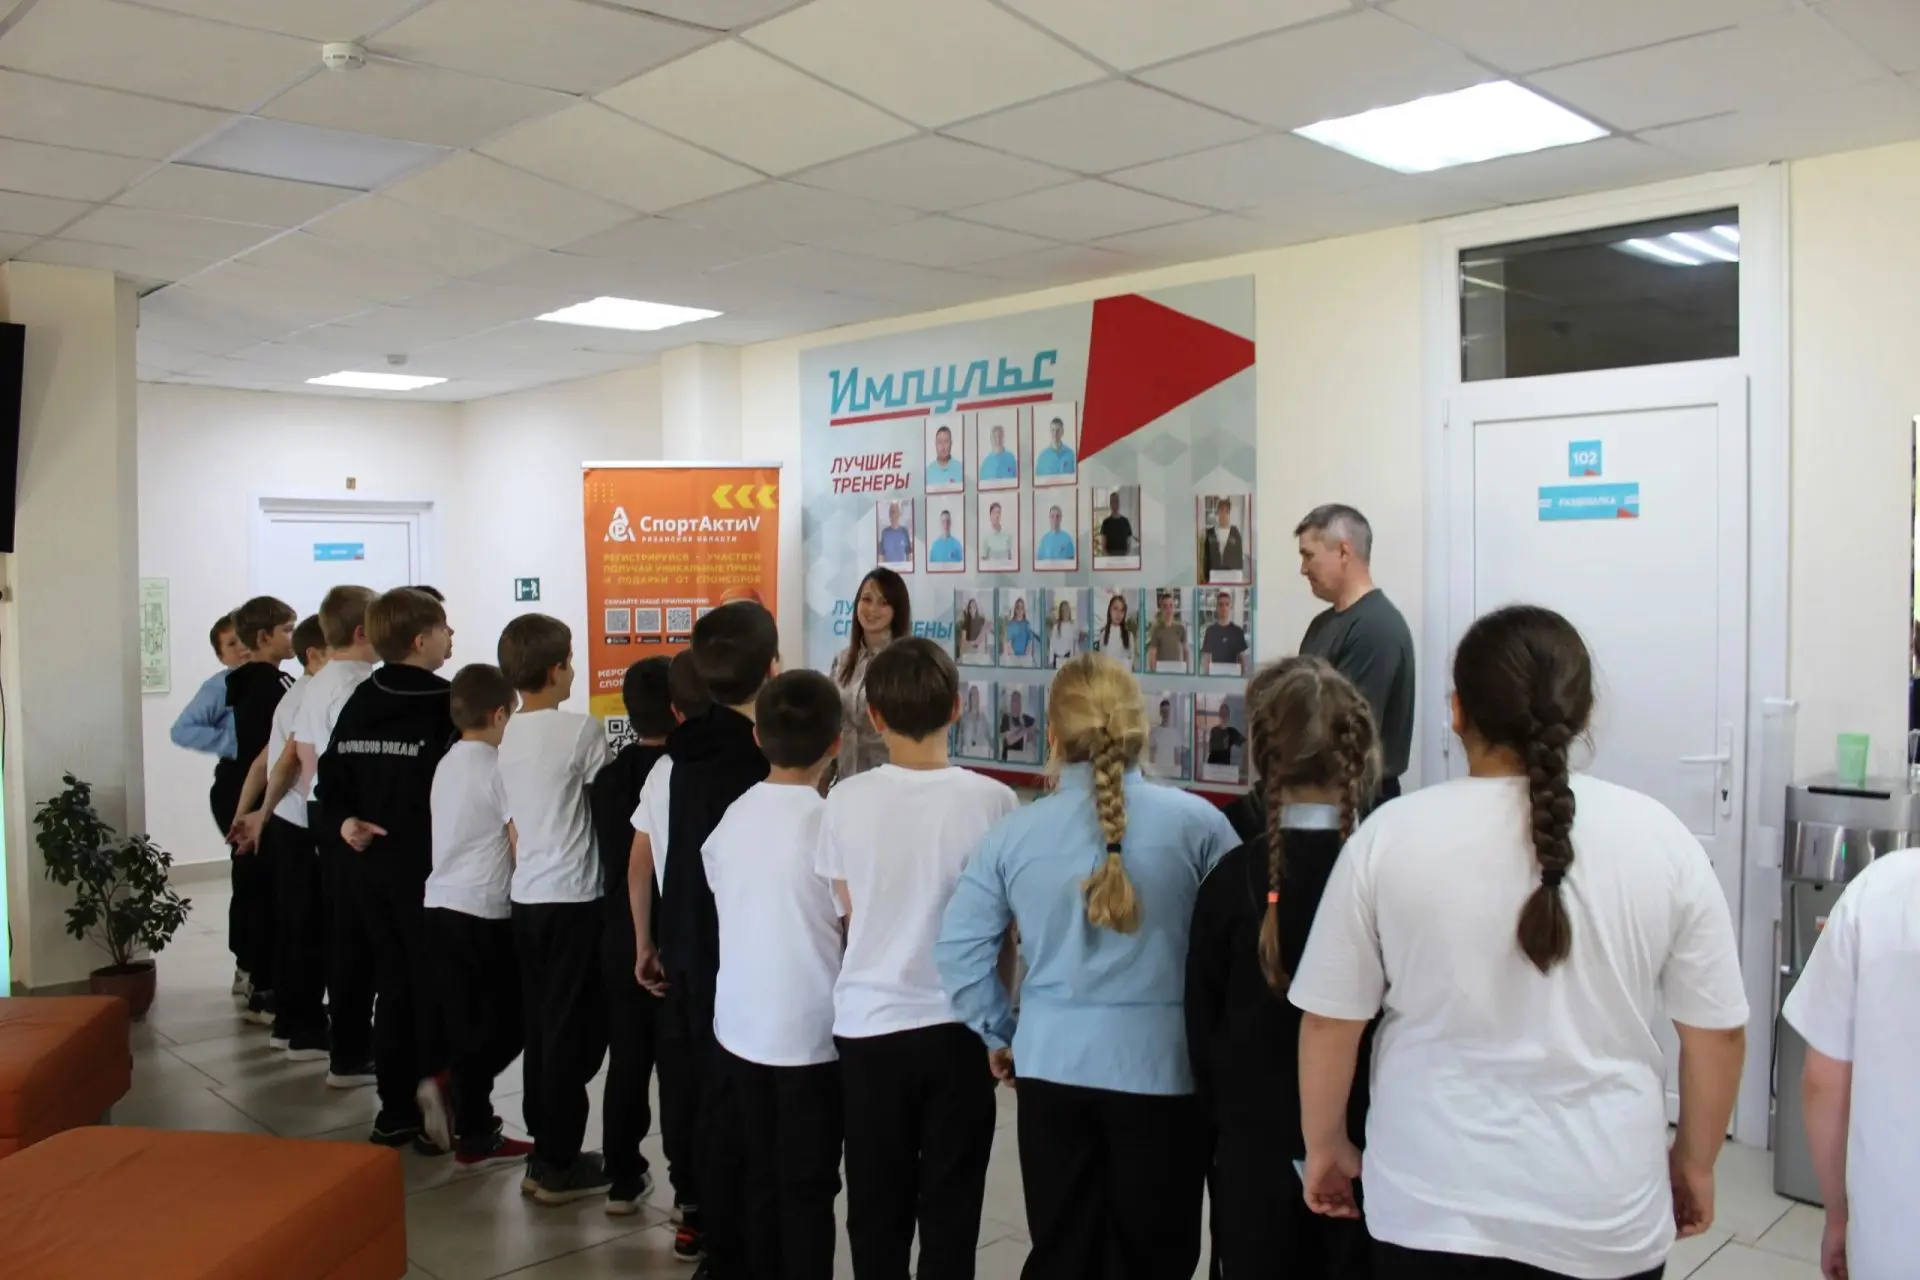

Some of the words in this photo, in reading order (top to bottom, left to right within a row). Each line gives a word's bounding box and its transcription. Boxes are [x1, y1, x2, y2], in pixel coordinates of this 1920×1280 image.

[828, 349, 1058, 415] Импульс
[830, 451, 904, 475] ЛУЧШИЕ
[1572, 451, 1597, 465] 102
[831, 472, 910, 495] ТРЕНЕРЫ
[603, 552, 690, 562] РЕГИСТРИРУЙСЯ
[603, 563, 653, 574] ПОЛУЧАЙ
[655, 564, 724, 574] УНИКАЛЬНЫЕ
[726, 564, 761, 574] ПРИЗЫ
[619, 575, 668, 585] ПОДАРКИ
